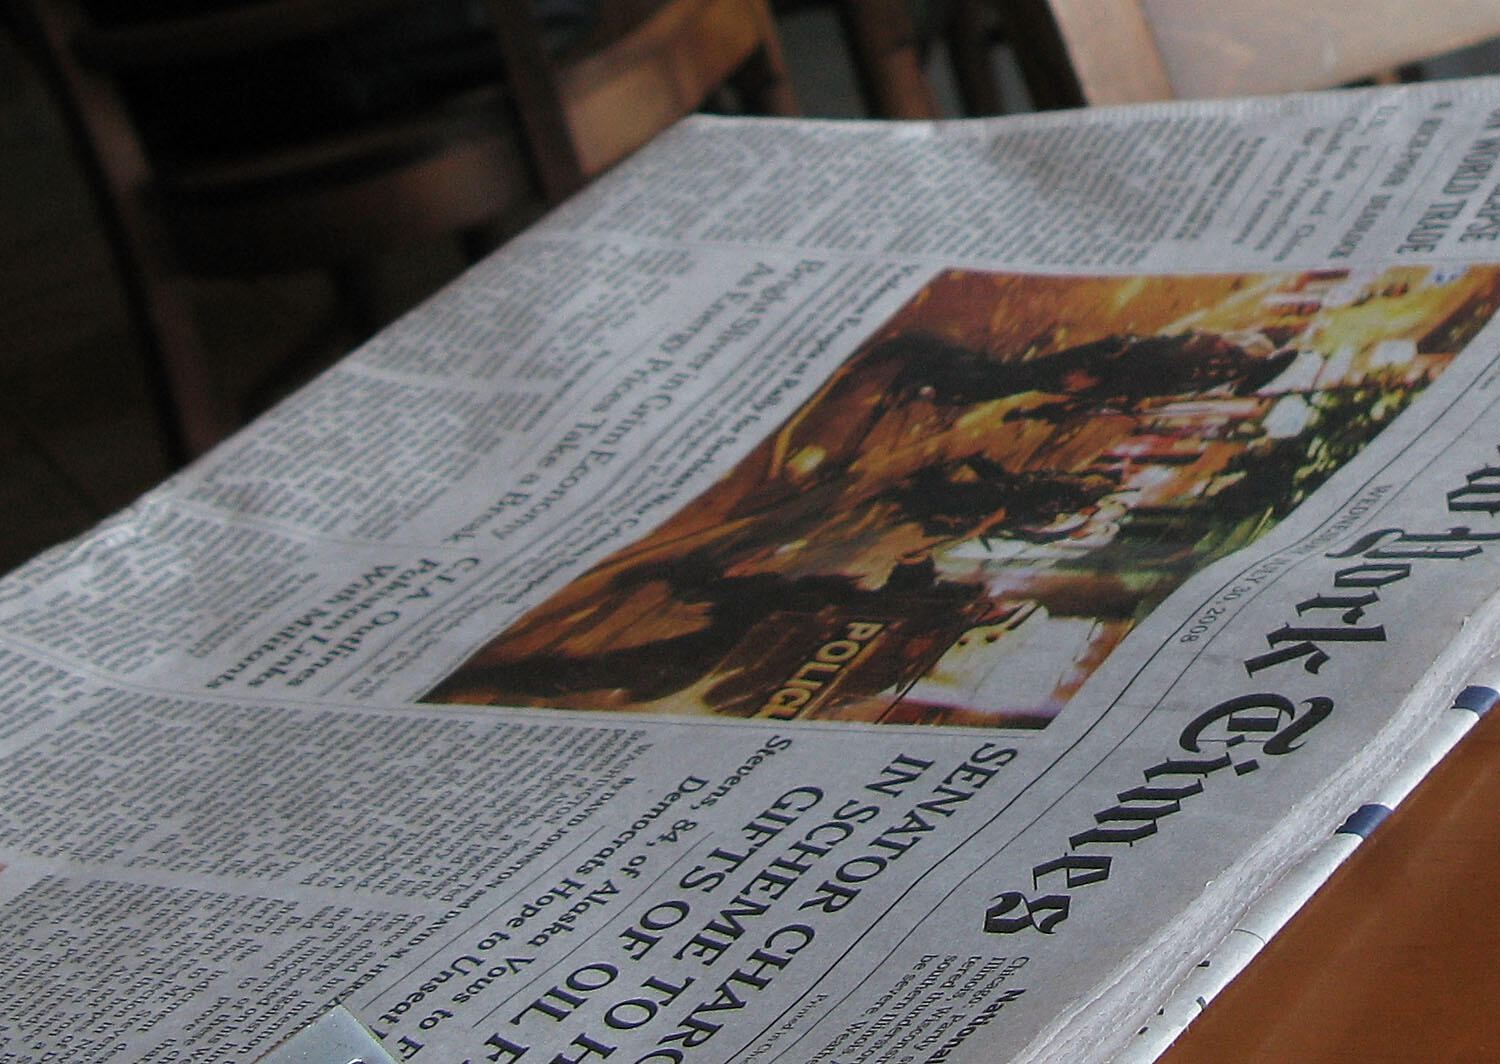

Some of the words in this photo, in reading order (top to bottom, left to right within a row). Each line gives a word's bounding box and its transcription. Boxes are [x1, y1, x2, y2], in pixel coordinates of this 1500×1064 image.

[1396, 199, 1468, 254] TRADE
[591, 358, 675, 413] Prices
[658, 372, 698, 391] in
[600, 394, 674, 445] Grim
[537, 419, 607, 468] Take
[491, 450, 618, 540] Economy
[517, 473, 540, 485] a
[442, 491, 532, 543] Break
[322, 558, 439, 630] Pakistan
[325, 565, 397, 604] With
[398, 557, 481, 604] C.I.A.
[1215, 586, 1251, 604] 30,
[1180, 608, 1226, 643] 2008
[205, 608, 330, 689] Militants
[248, 635, 330, 687] Links
[286, 611, 400, 687] Outlines
[543, 744, 653, 825] WASHINGTON
[611, 778, 636, 791] By
[690, 735, 793, 810] Stevens,
[865, 754, 935, 797] IN
[567, 793, 616, 826] DAVID
[576, 776, 709, 875] Democrats
[798, 743, 1018, 913] SENATOR
[983, 693, 1334, 934] Times
[646, 819, 698, 846] 84,
[679, 787, 824, 893] GIFTS
[470, 839, 530, 880] Senator
[485, 829, 569, 888] JOHNSTON
[620, 855, 647, 879] of
[404, 880, 433, 897] the
[440, 883, 475, 902] Ted
[457, 890, 486, 909] and
[673, 800, 880, 966] SCHEME
[253, 901, 299, 933] sharp
[321, 907, 352, 929] and
[506, 878, 585, 928] Hope
[527, 879, 620, 947] Alaska
[270, 916, 303, 935] But
[310, 912, 390, 966] statement
[322, 925, 350, 943] am
[379, 914, 410, 932] the
[380, 915, 426, 947] cence
[408, 910, 461, 946] DAVID
[477, 932, 510, 950] to
[619, 901, 690, 961] OF
[212, 938, 252, 962] blow
[234, 945, 263, 962] the
[263, 936, 319, 970] intend
[309, 939, 373, 982] charges
[344, 952, 376, 973] and
[384, 948, 410, 961] M.
[913, 955, 939, 970] be
[188, 968, 208, 979] to
[237, 977, 258, 989] to
[251, 947, 324, 993] innocent
[256, 968, 312, 1006] posted
[314, 978, 346, 995] his
[452, 958, 536, 1003] Vows
[891, 956, 957, 1010] southern
[940, 956, 982, 989] tered
[945, 957, 1007, 1001] Illinois,
[962, 957, 1029, 1008] Chicago:
[136, 970, 226, 1032] indictment
[152, 985, 186, 1004] Mr.
[230, 998, 250, 1010] of
[378, 956, 485, 1024] Unseat
[510, 964, 618, 1025] OIL
[604, 976, 695, 1030] TO
[860, 974, 916, 1017] severe.
[182, 997, 231, 1031] prove
[183, 1014, 231, 1046] these
[233, 1008, 257, 1023] on
[236, 1000, 314, 1054] intention
[241, 990, 302, 1034] against
[419, 1010, 453, 1030] to
[207, 1026, 238, 1044] his
[390, 1034, 425, 1063] F
[462, 1033, 530, 1064] F
[767, 1032, 786, 1041] in
[837, 1014, 898, 1057] Illinois.
[913, 1014, 966, 1051] Partly
